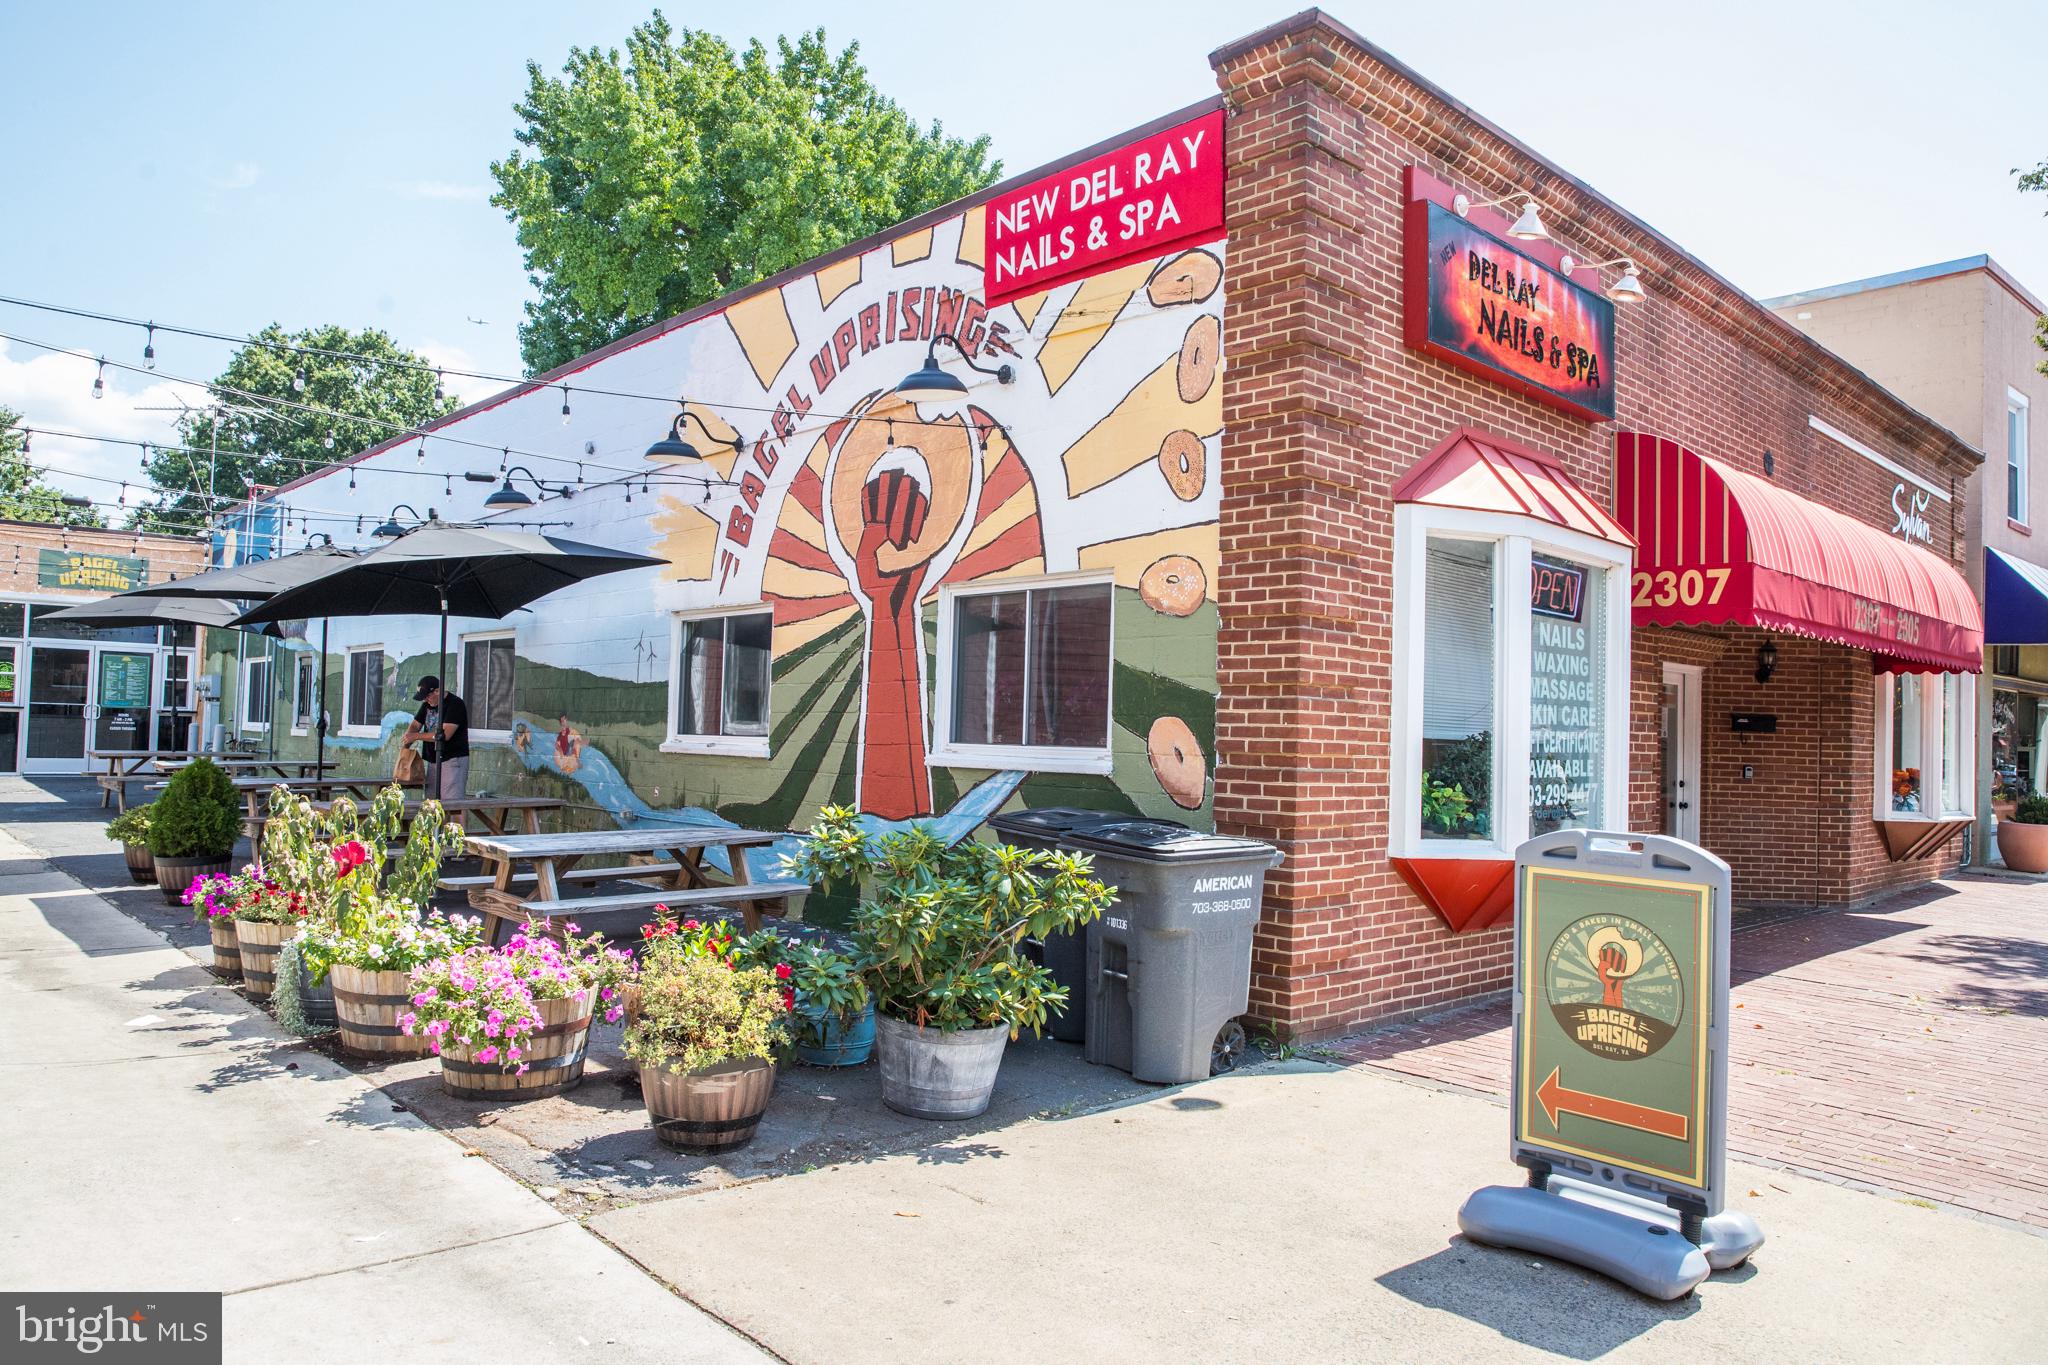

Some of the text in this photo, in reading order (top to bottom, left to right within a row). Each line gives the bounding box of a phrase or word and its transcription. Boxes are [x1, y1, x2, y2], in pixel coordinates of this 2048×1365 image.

[996, 130, 1205, 239] NEW DEL RAY
[995, 192, 1181, 283] NAILS & SPA
[1440, 241, 1457, 266] NEW
[1469, 250, 1540, 312] DEL RAY
[1477, 297, 1601, 389] NAILS & SPA
[726, 285, 988, 548] BAGEL UPRISING
[70, 557, 119, 570] BAGEL
[59, 569, 130, 590] UPRISING
[1631, 568, 1732, 608] 2307
[1540, 622, 1585, 651] NAILS
[1534, 651, 1589, 676] WAXING
[1531, 704, 1597, 726] KIN CARE
[1529, 759, 1594, 779] AVAILABLE
[1529, 783, 1600, 807] 03-299-4477
[1193, 875, 1253, 893] AMERICAN
[1192, 898, 1252, 914] 703-368-0500
[1551, 932, 1570, 961] BOILED
[1579, 917, 1607, 929] BAKED
[1625, 919, 1652, 940] SMALL
[1654, 940, 1680, 980] BATCHES
[1587, 1008, 1637, 1031] BAGEL
[1577, 1023, 1649, 1054] UPRISING
[1593, 1043, 1603, 1051] DEL
